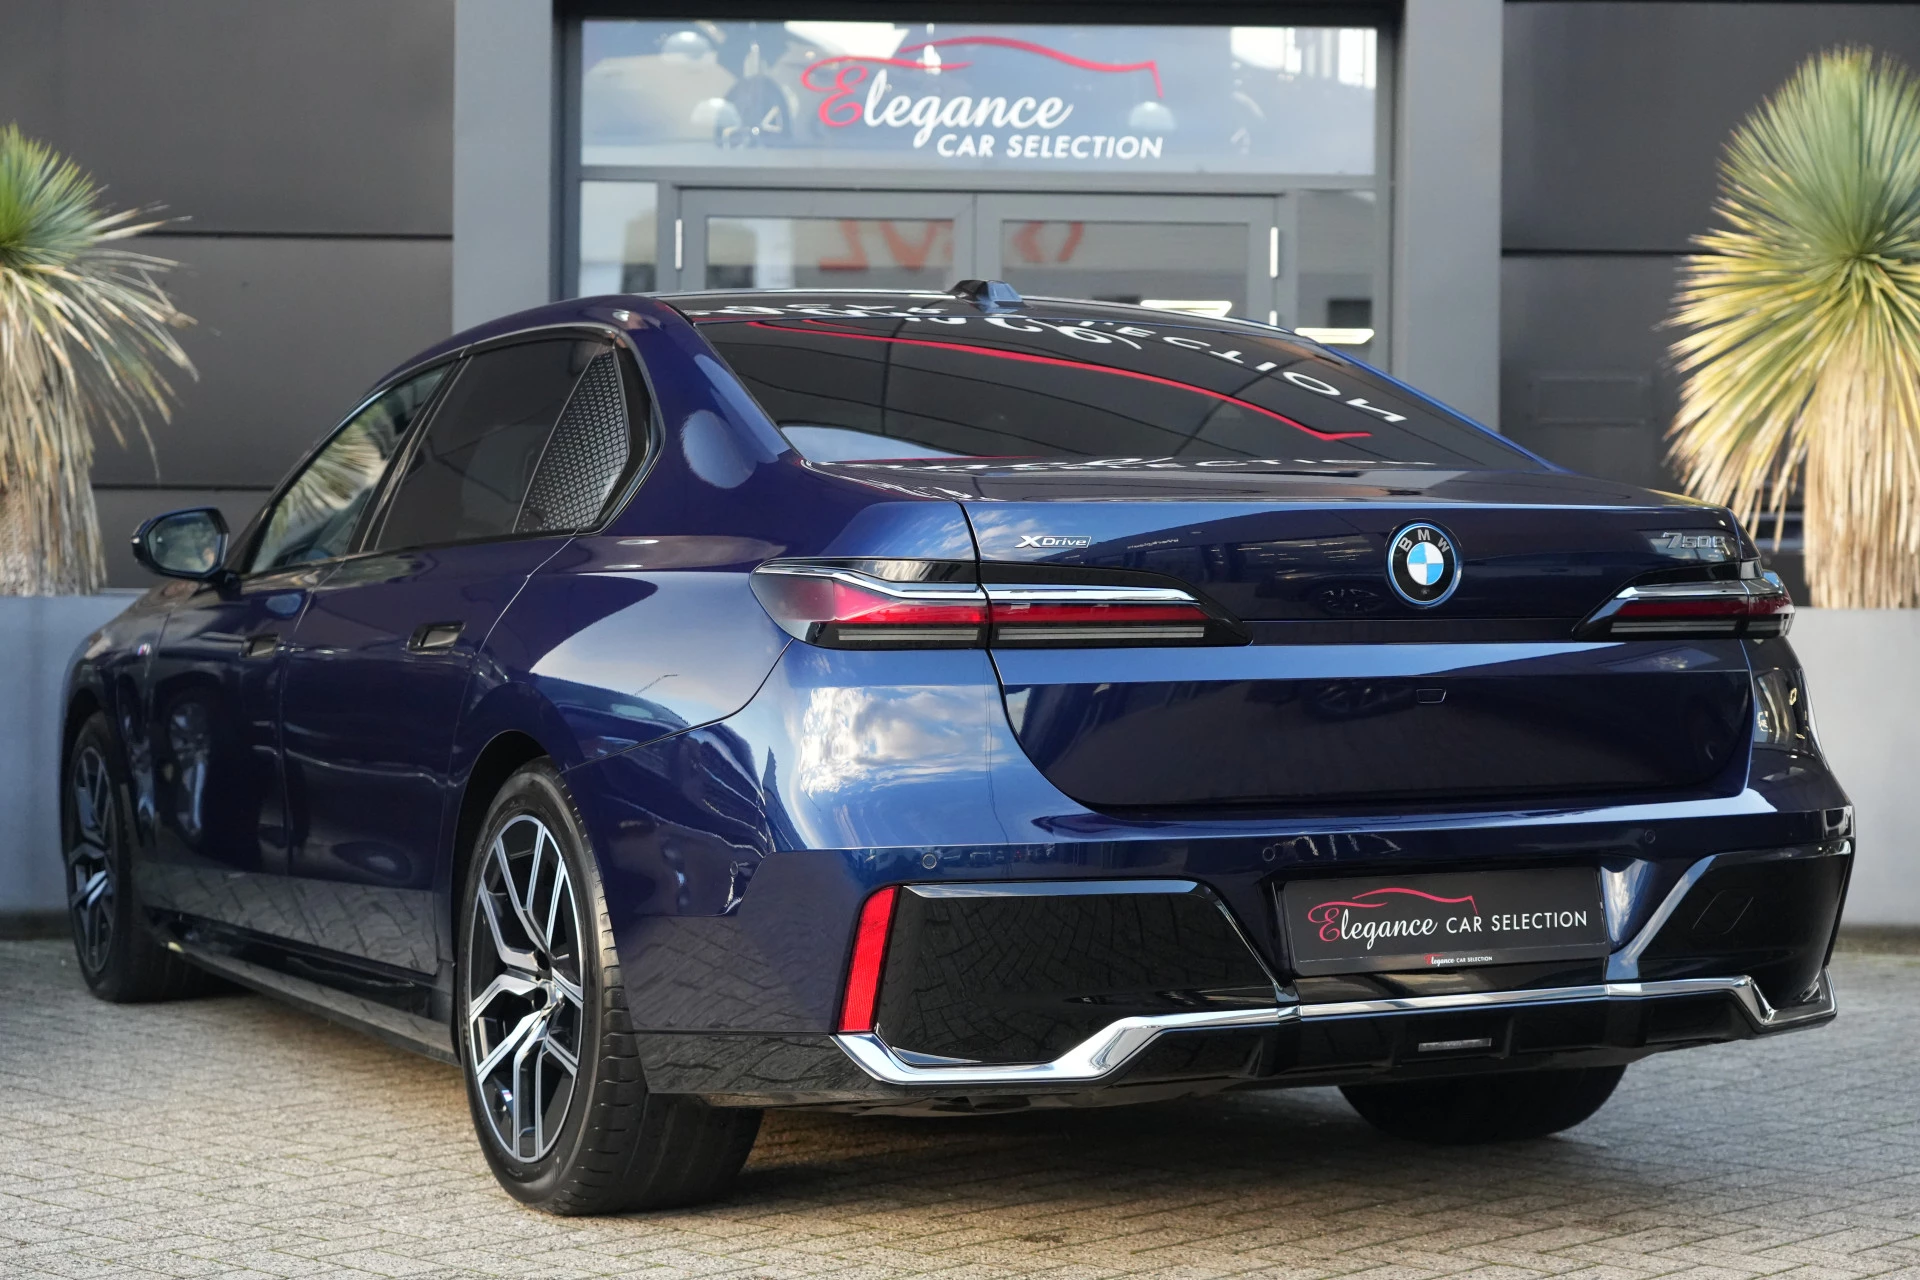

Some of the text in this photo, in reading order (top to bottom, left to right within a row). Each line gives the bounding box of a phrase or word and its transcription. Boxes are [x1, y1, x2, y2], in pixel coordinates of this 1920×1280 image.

[802, 56, 1074, 148] Elegance
[936, 133, 1164, 159] CAR SELECTION
[1398, 529, 1450, 552] BMW
[1308, 901, 1588, 950] Elegance CAR SELECTION
